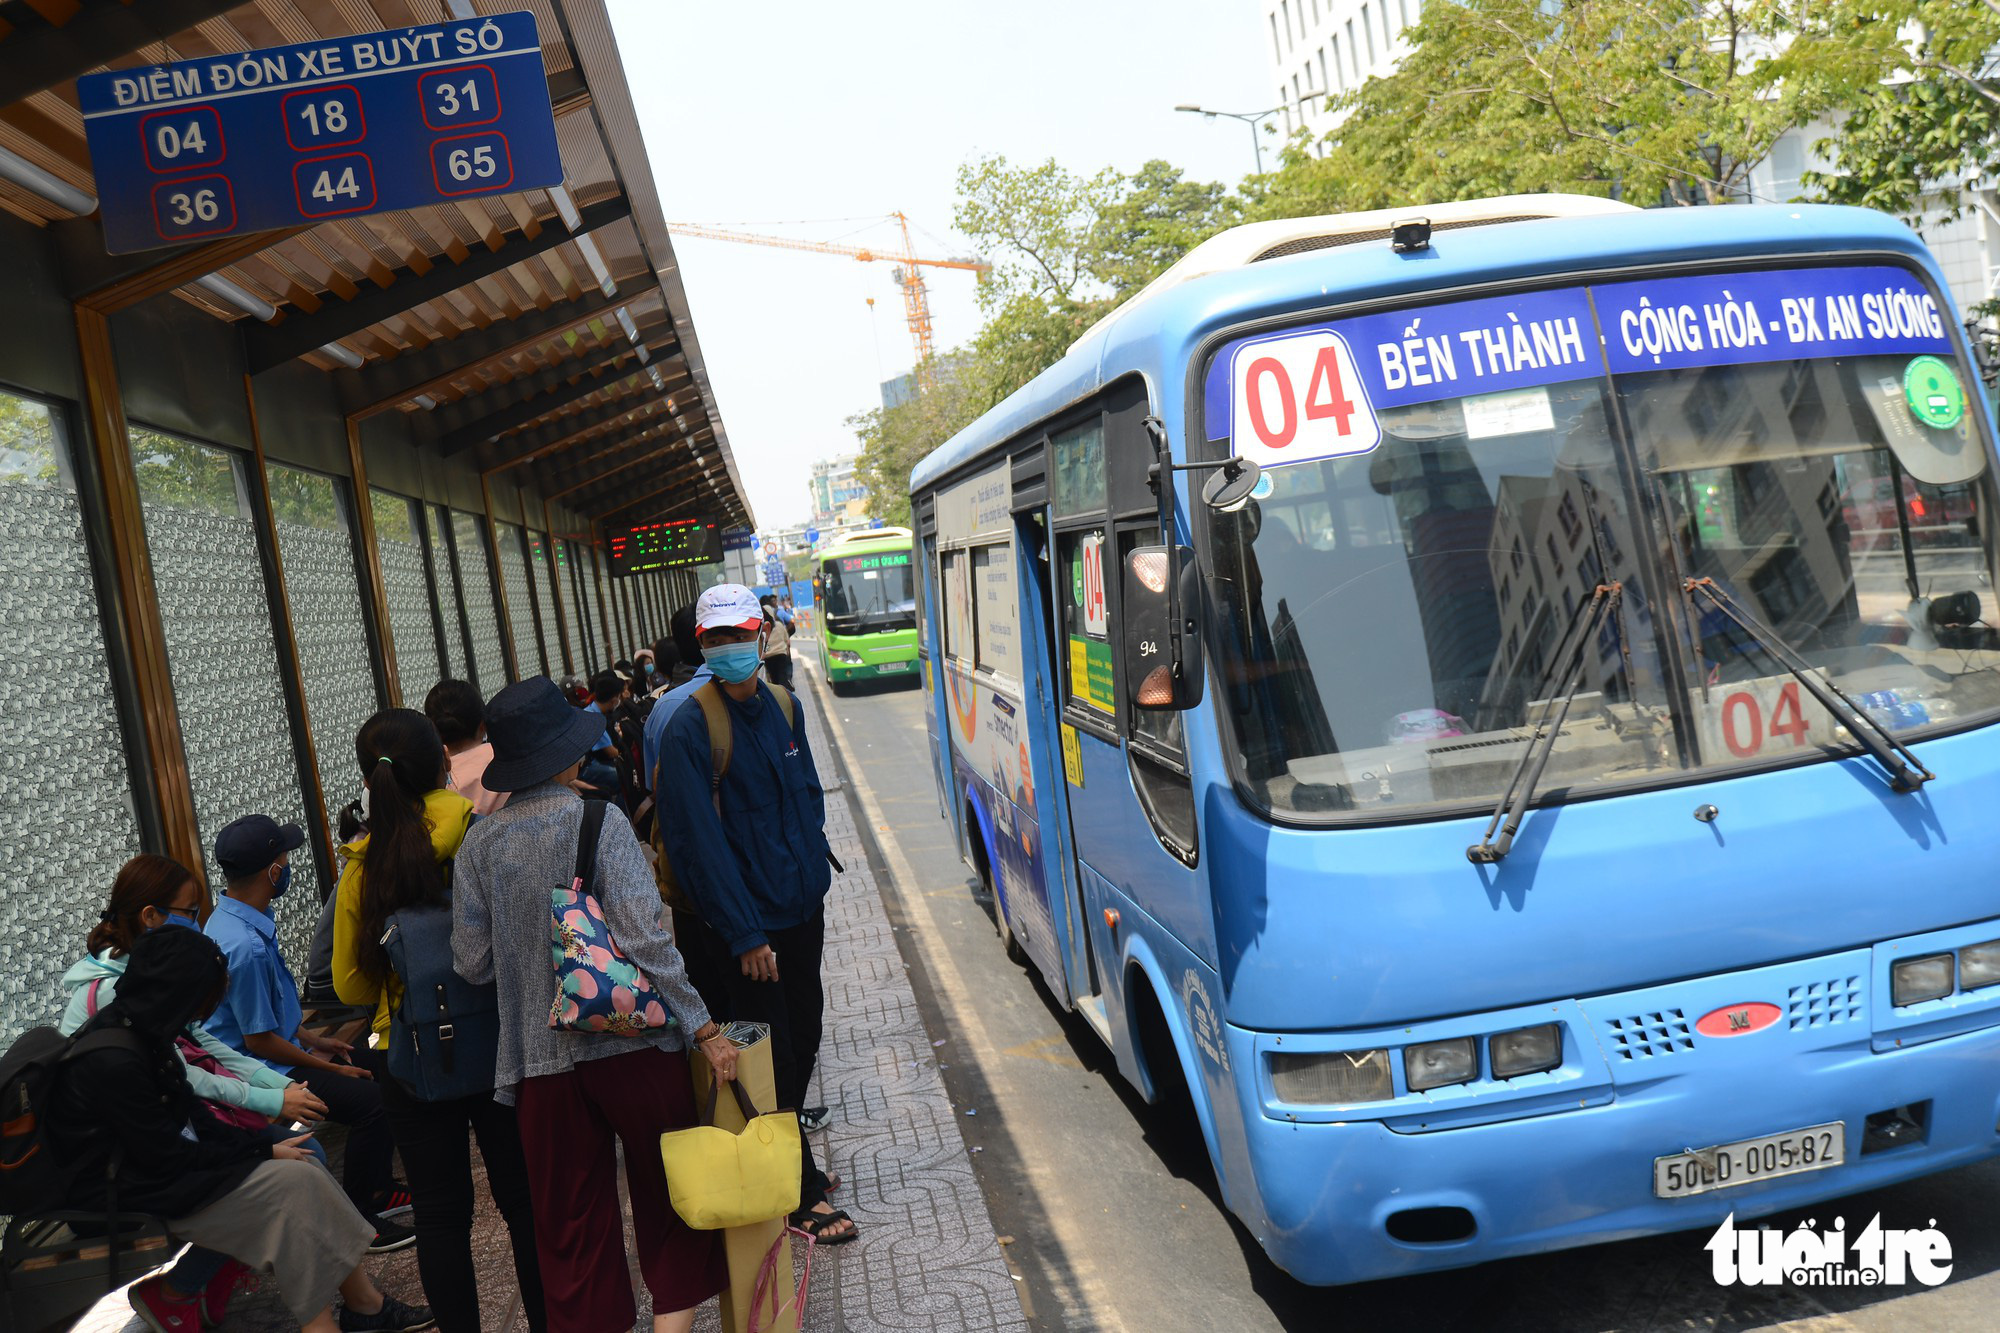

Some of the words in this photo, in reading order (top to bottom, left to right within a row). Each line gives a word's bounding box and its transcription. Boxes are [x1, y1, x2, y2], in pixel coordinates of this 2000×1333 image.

[114, 68, 202, 106] ĐIỂM
[211, 53, 288, 93] ĐÓN
[300, 47, 343, 79] XE
[354, 30, 445, 71] BUÝT
[455, 18, 504, 55] SỐ
[435, 79, 480, 117] 31
[301, 100, 348, 136] 18
[157, 121, 206, 160] 04
[448, 145, 496, 182] 65
[311, 167, 360, 202] 44
[170, 189, 219, 227] 36
[1377, 318, 1458, 391] BẾN
[1459, 312, 1586, 377] THÀNH
[1620, 296, 1704, 365] CỘNG
[1703, 289, 1768, 349] HÒA
[1769, 321, 1781, 332] -
[1781, 297, 1825, 343] BX
[1825, 294, 1864, 340] AN
[1861, 287, 1945, 339] SƯƠNG
[1245, 345, 1355, 450] 04
[1085, 543, 1103, 622] 04
[1140, 641, 1158, 657] 94
[1721, 681, 1809, 759] 04
[1728, 1009, 1750, 1031] M
